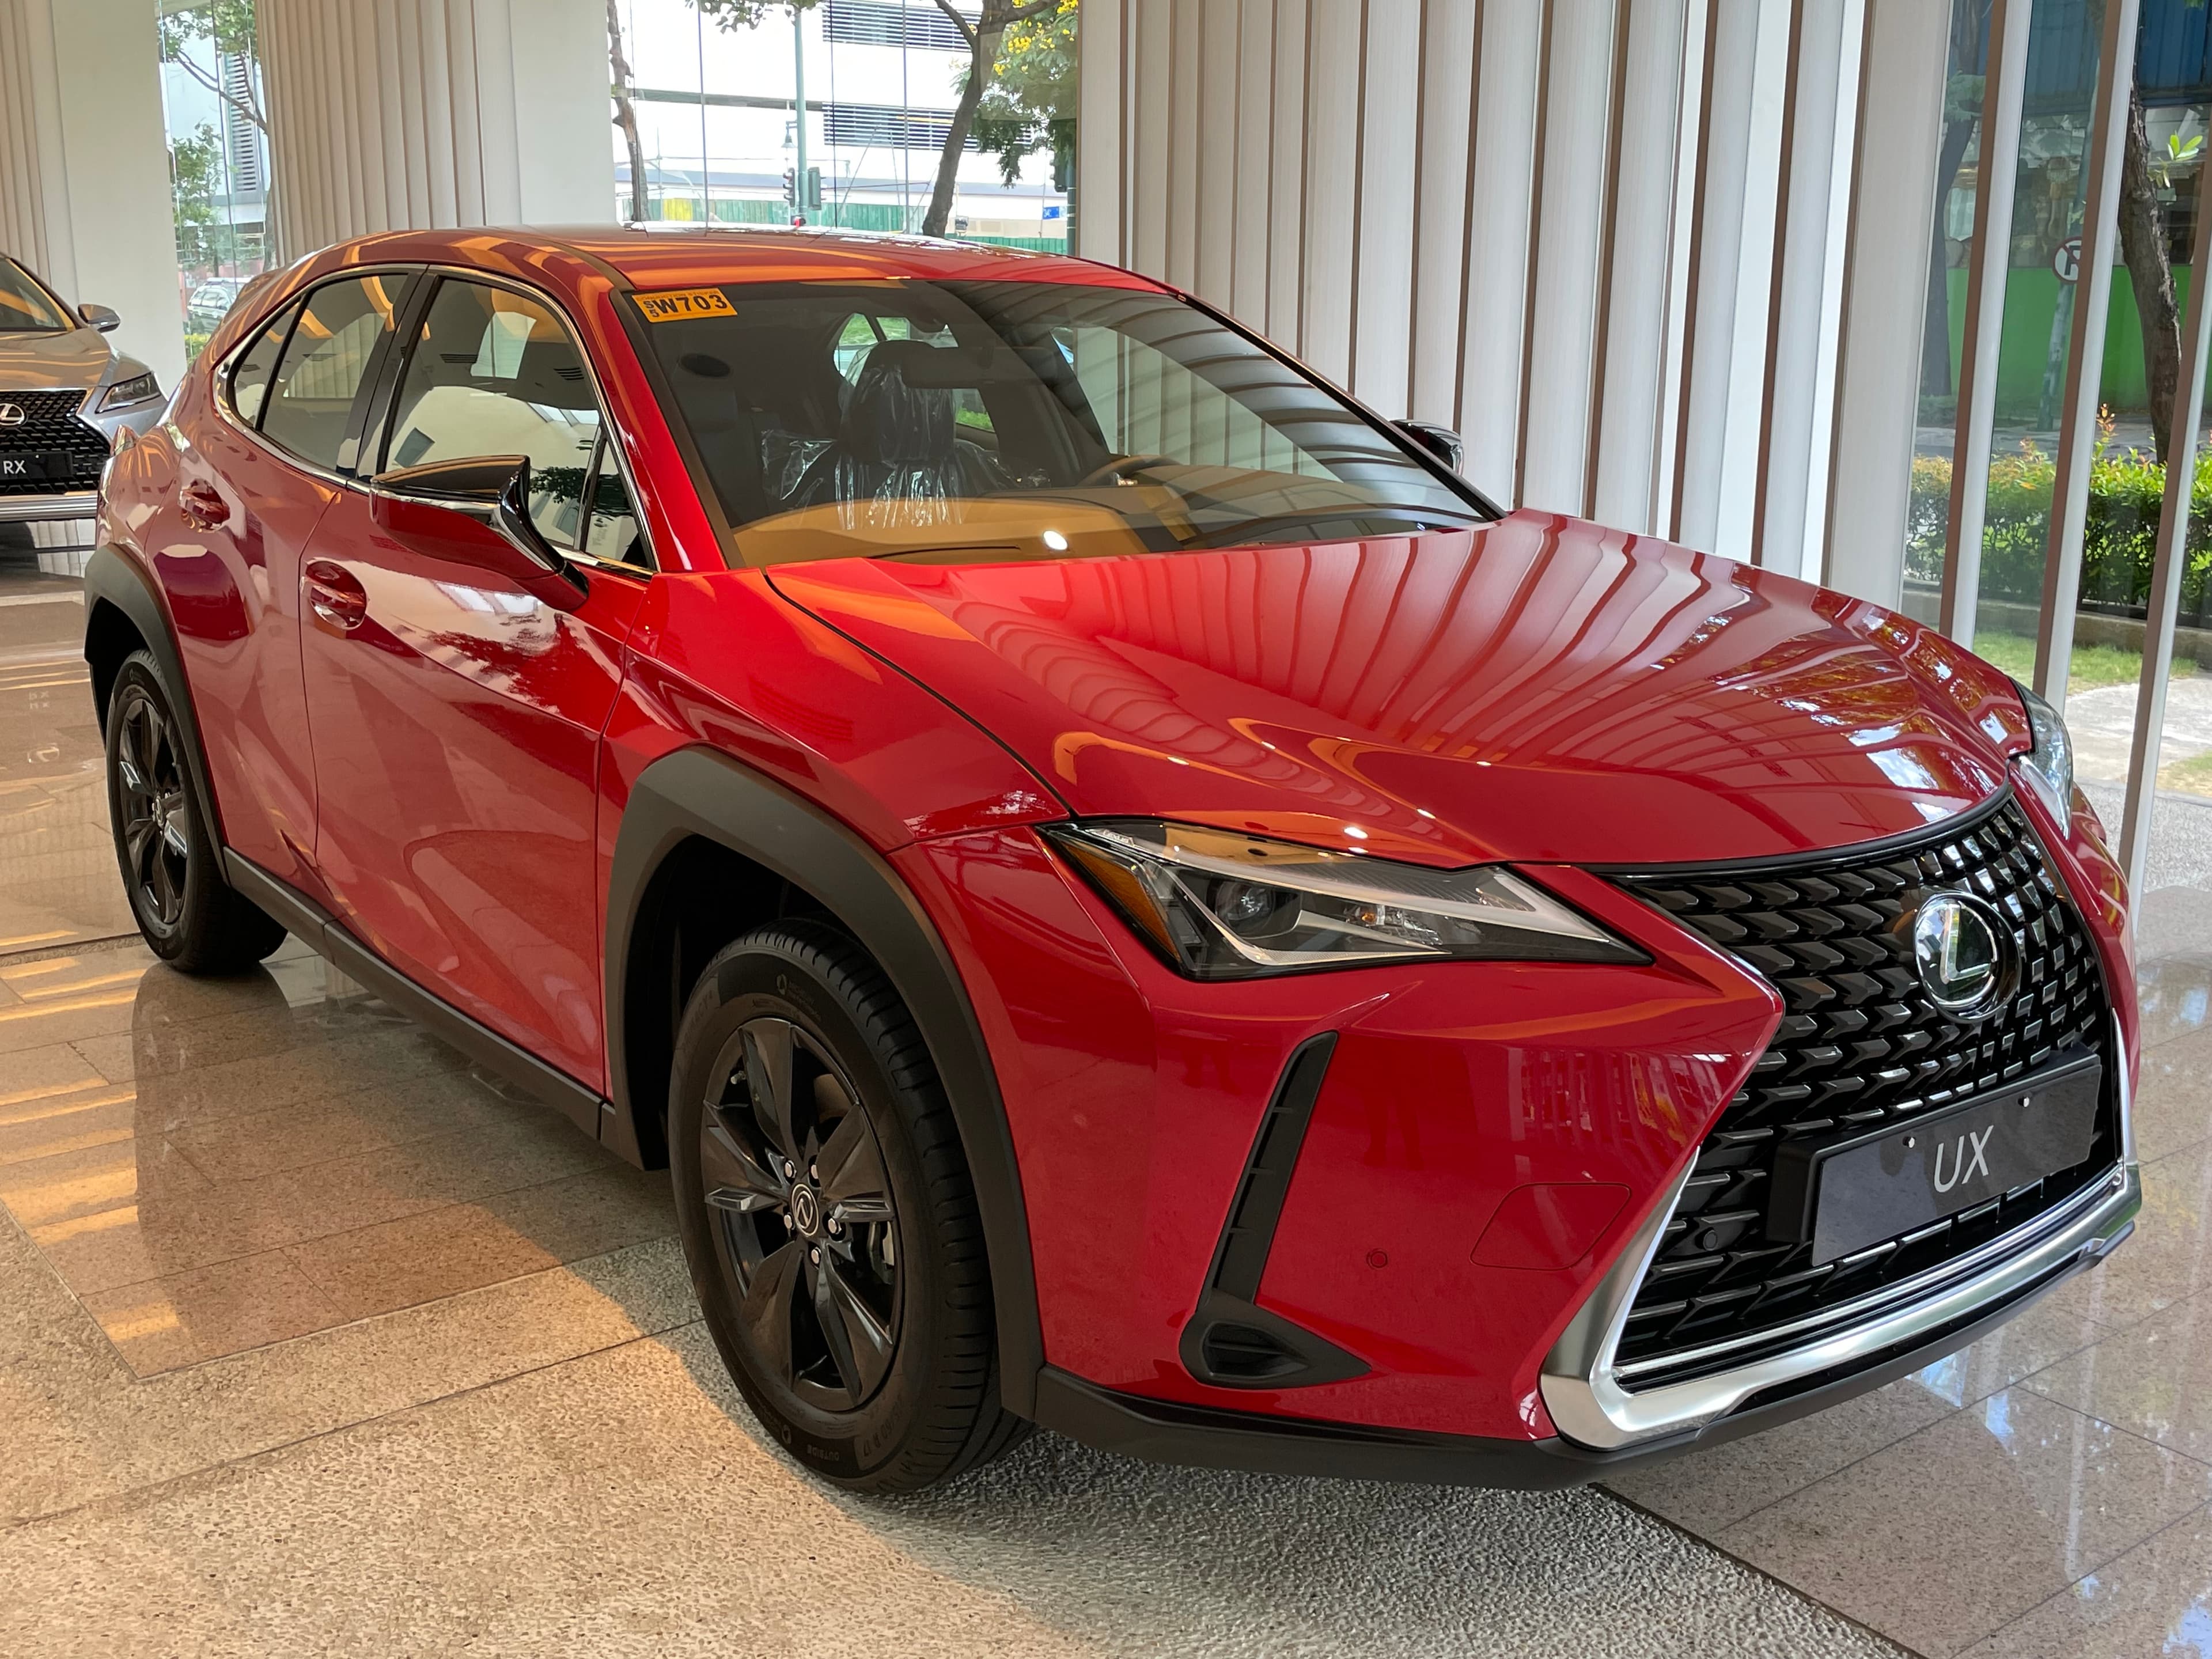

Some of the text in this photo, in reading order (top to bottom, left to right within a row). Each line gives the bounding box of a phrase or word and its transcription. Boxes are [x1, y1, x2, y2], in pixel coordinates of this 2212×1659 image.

[652, 294, 728, 314] W703
[3, 460, 26, 474] RX
[1933, 1124, 1994, 1193] UX
